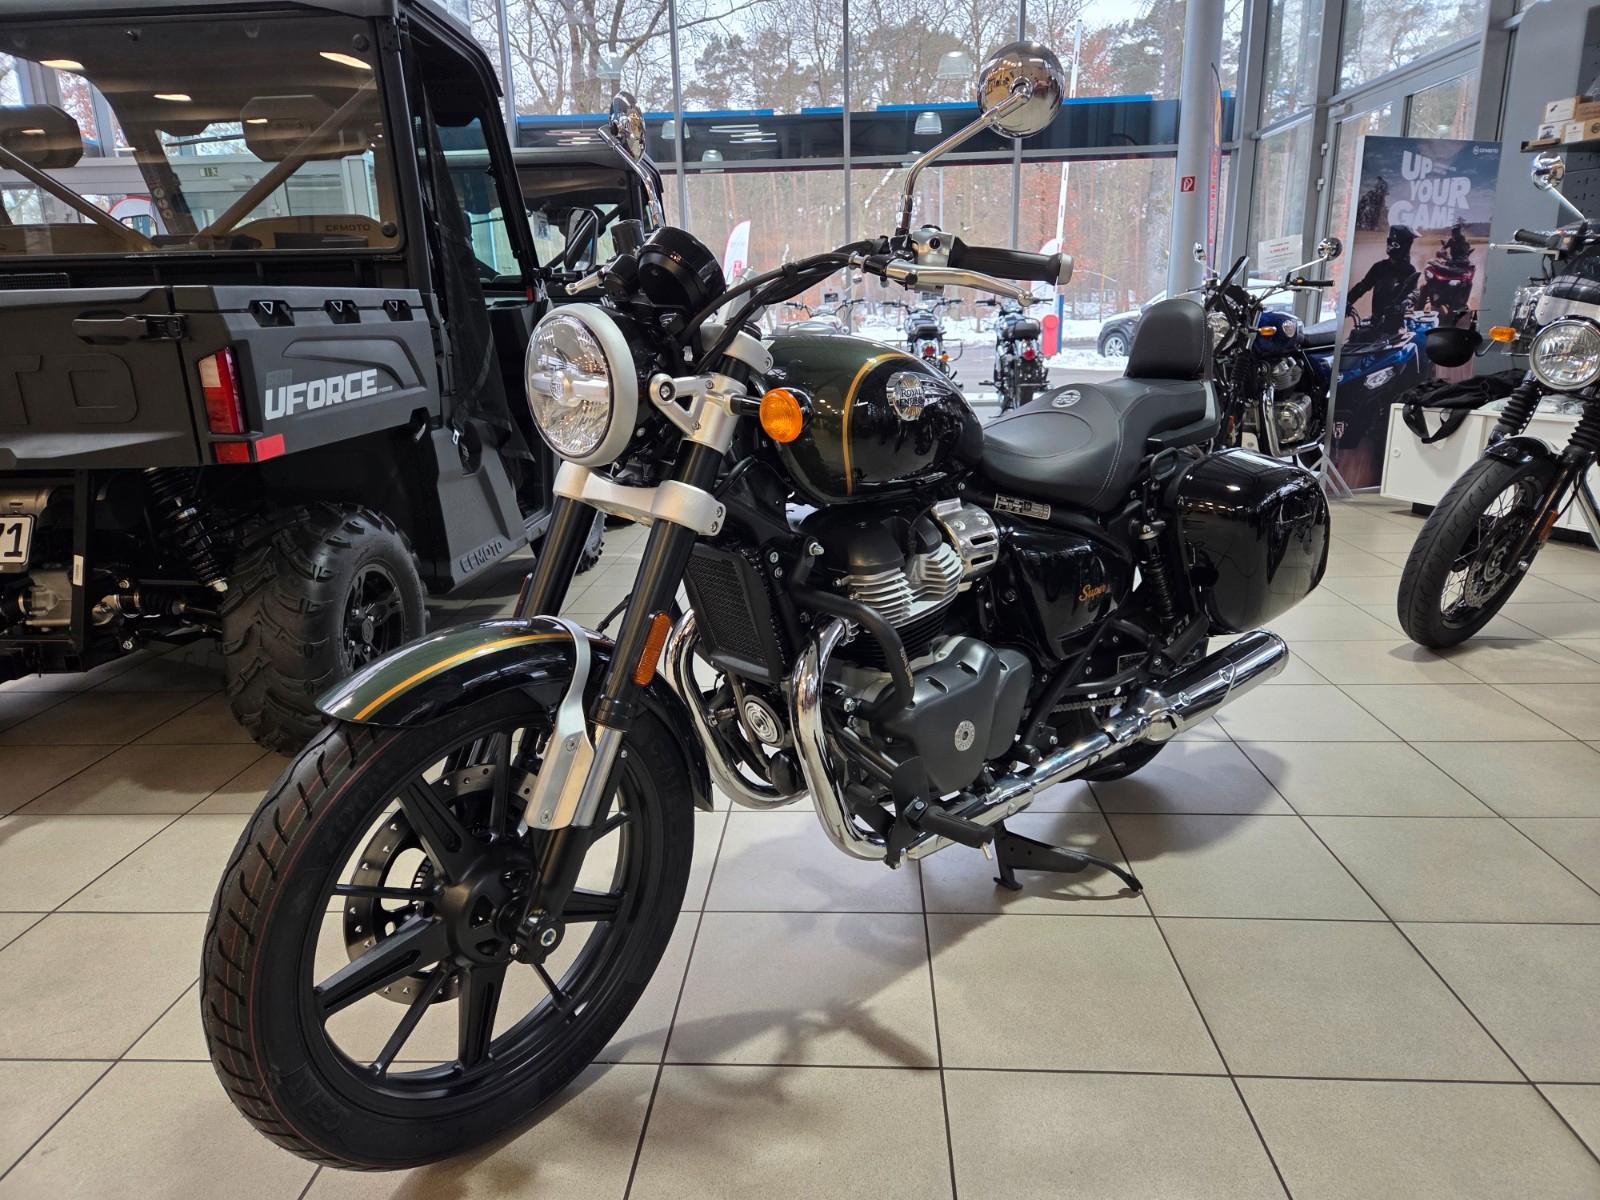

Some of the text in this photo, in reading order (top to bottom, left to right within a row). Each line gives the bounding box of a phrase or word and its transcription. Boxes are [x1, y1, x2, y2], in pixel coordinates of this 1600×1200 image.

[1401, 150, 1433, 181] UP
[1410, 176, 1472, 210] YOUR
[325, 223, 371, 233] CFMOTO
[1387, 200, 1456, 230] GAME
[264, 368, 378, 421] UFORCE
[900, 387, 923, 398] ROYAL
[459, 541, 503, 574] CFMOTO
